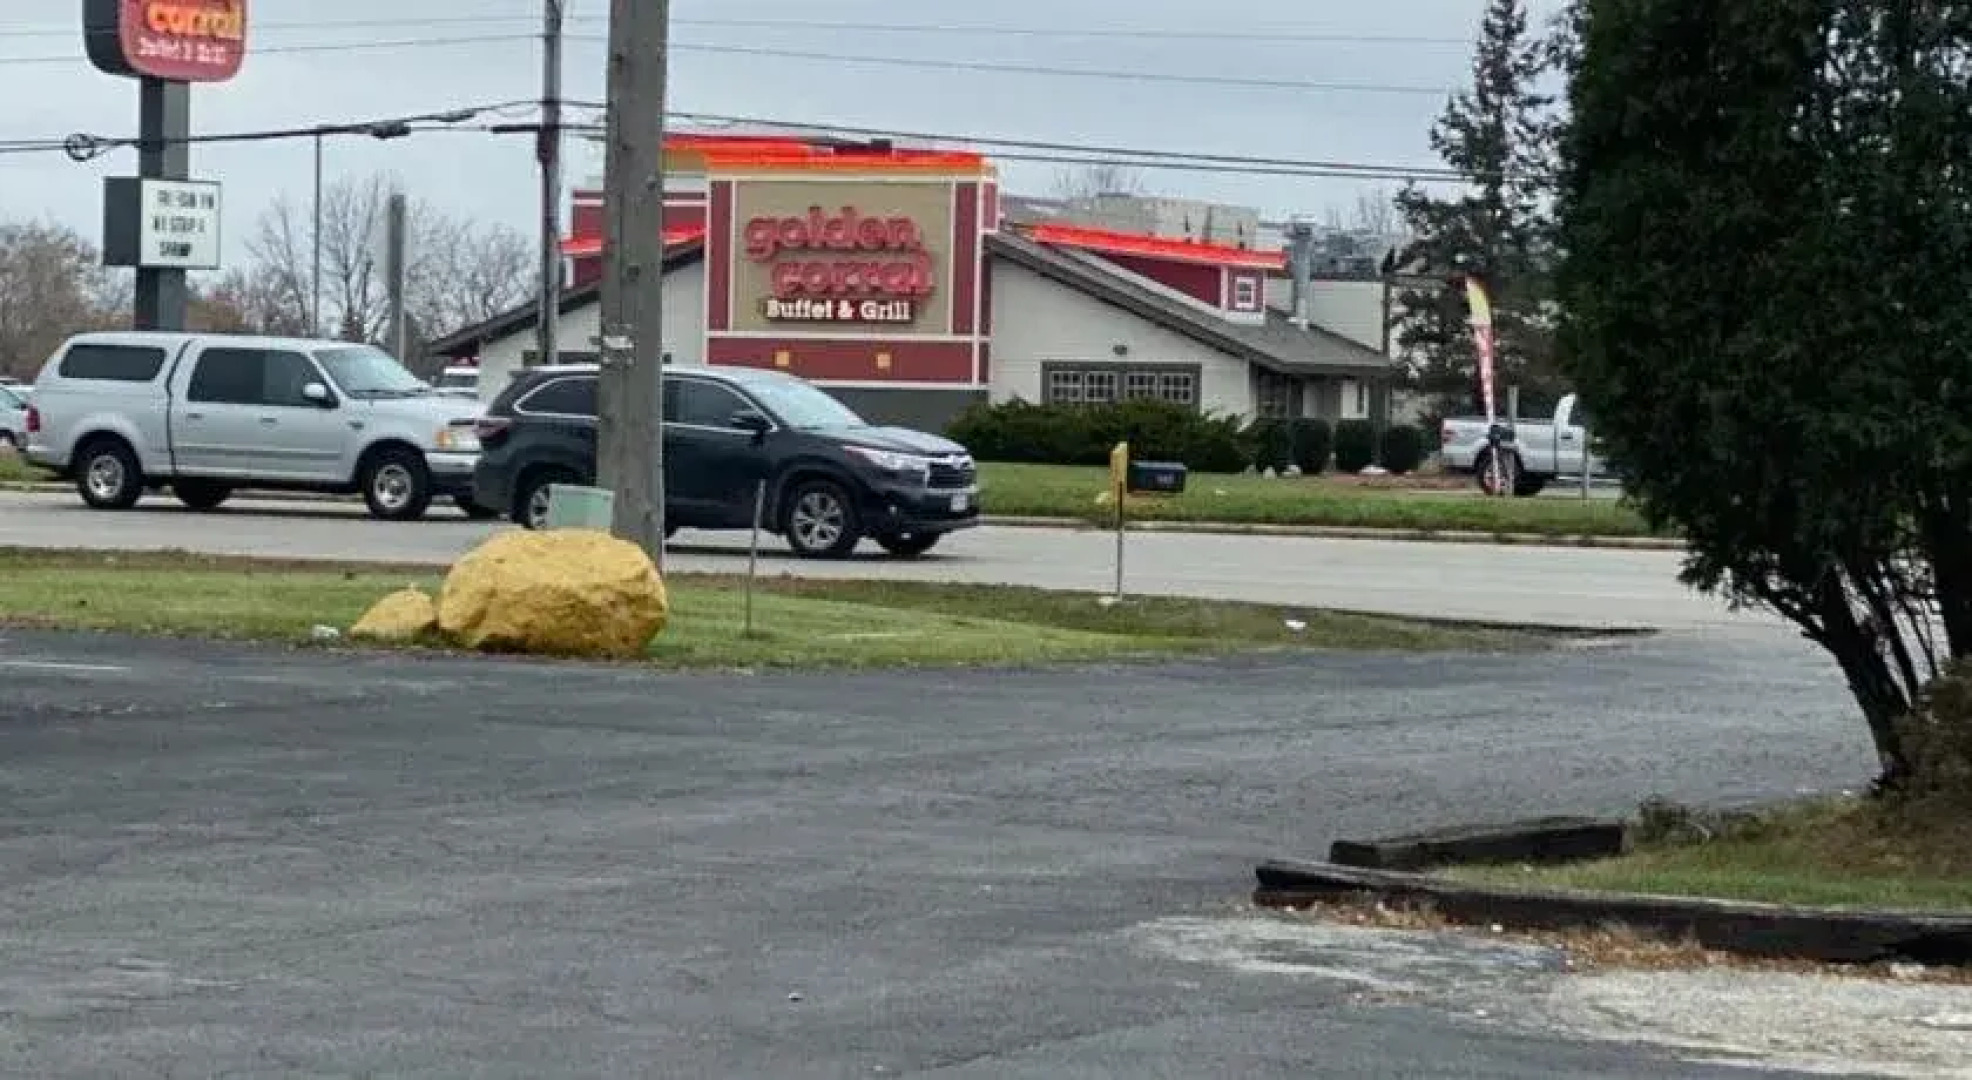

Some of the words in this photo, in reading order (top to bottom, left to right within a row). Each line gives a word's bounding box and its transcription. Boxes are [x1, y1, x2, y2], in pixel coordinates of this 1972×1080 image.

[743, 205, 922, 263] golden
[772, 249, 936, 303] corral
[766, 299, 833, 319] Buffet
[837, 300, 854, 320] &
[860, 301, 912, 321] Grill
